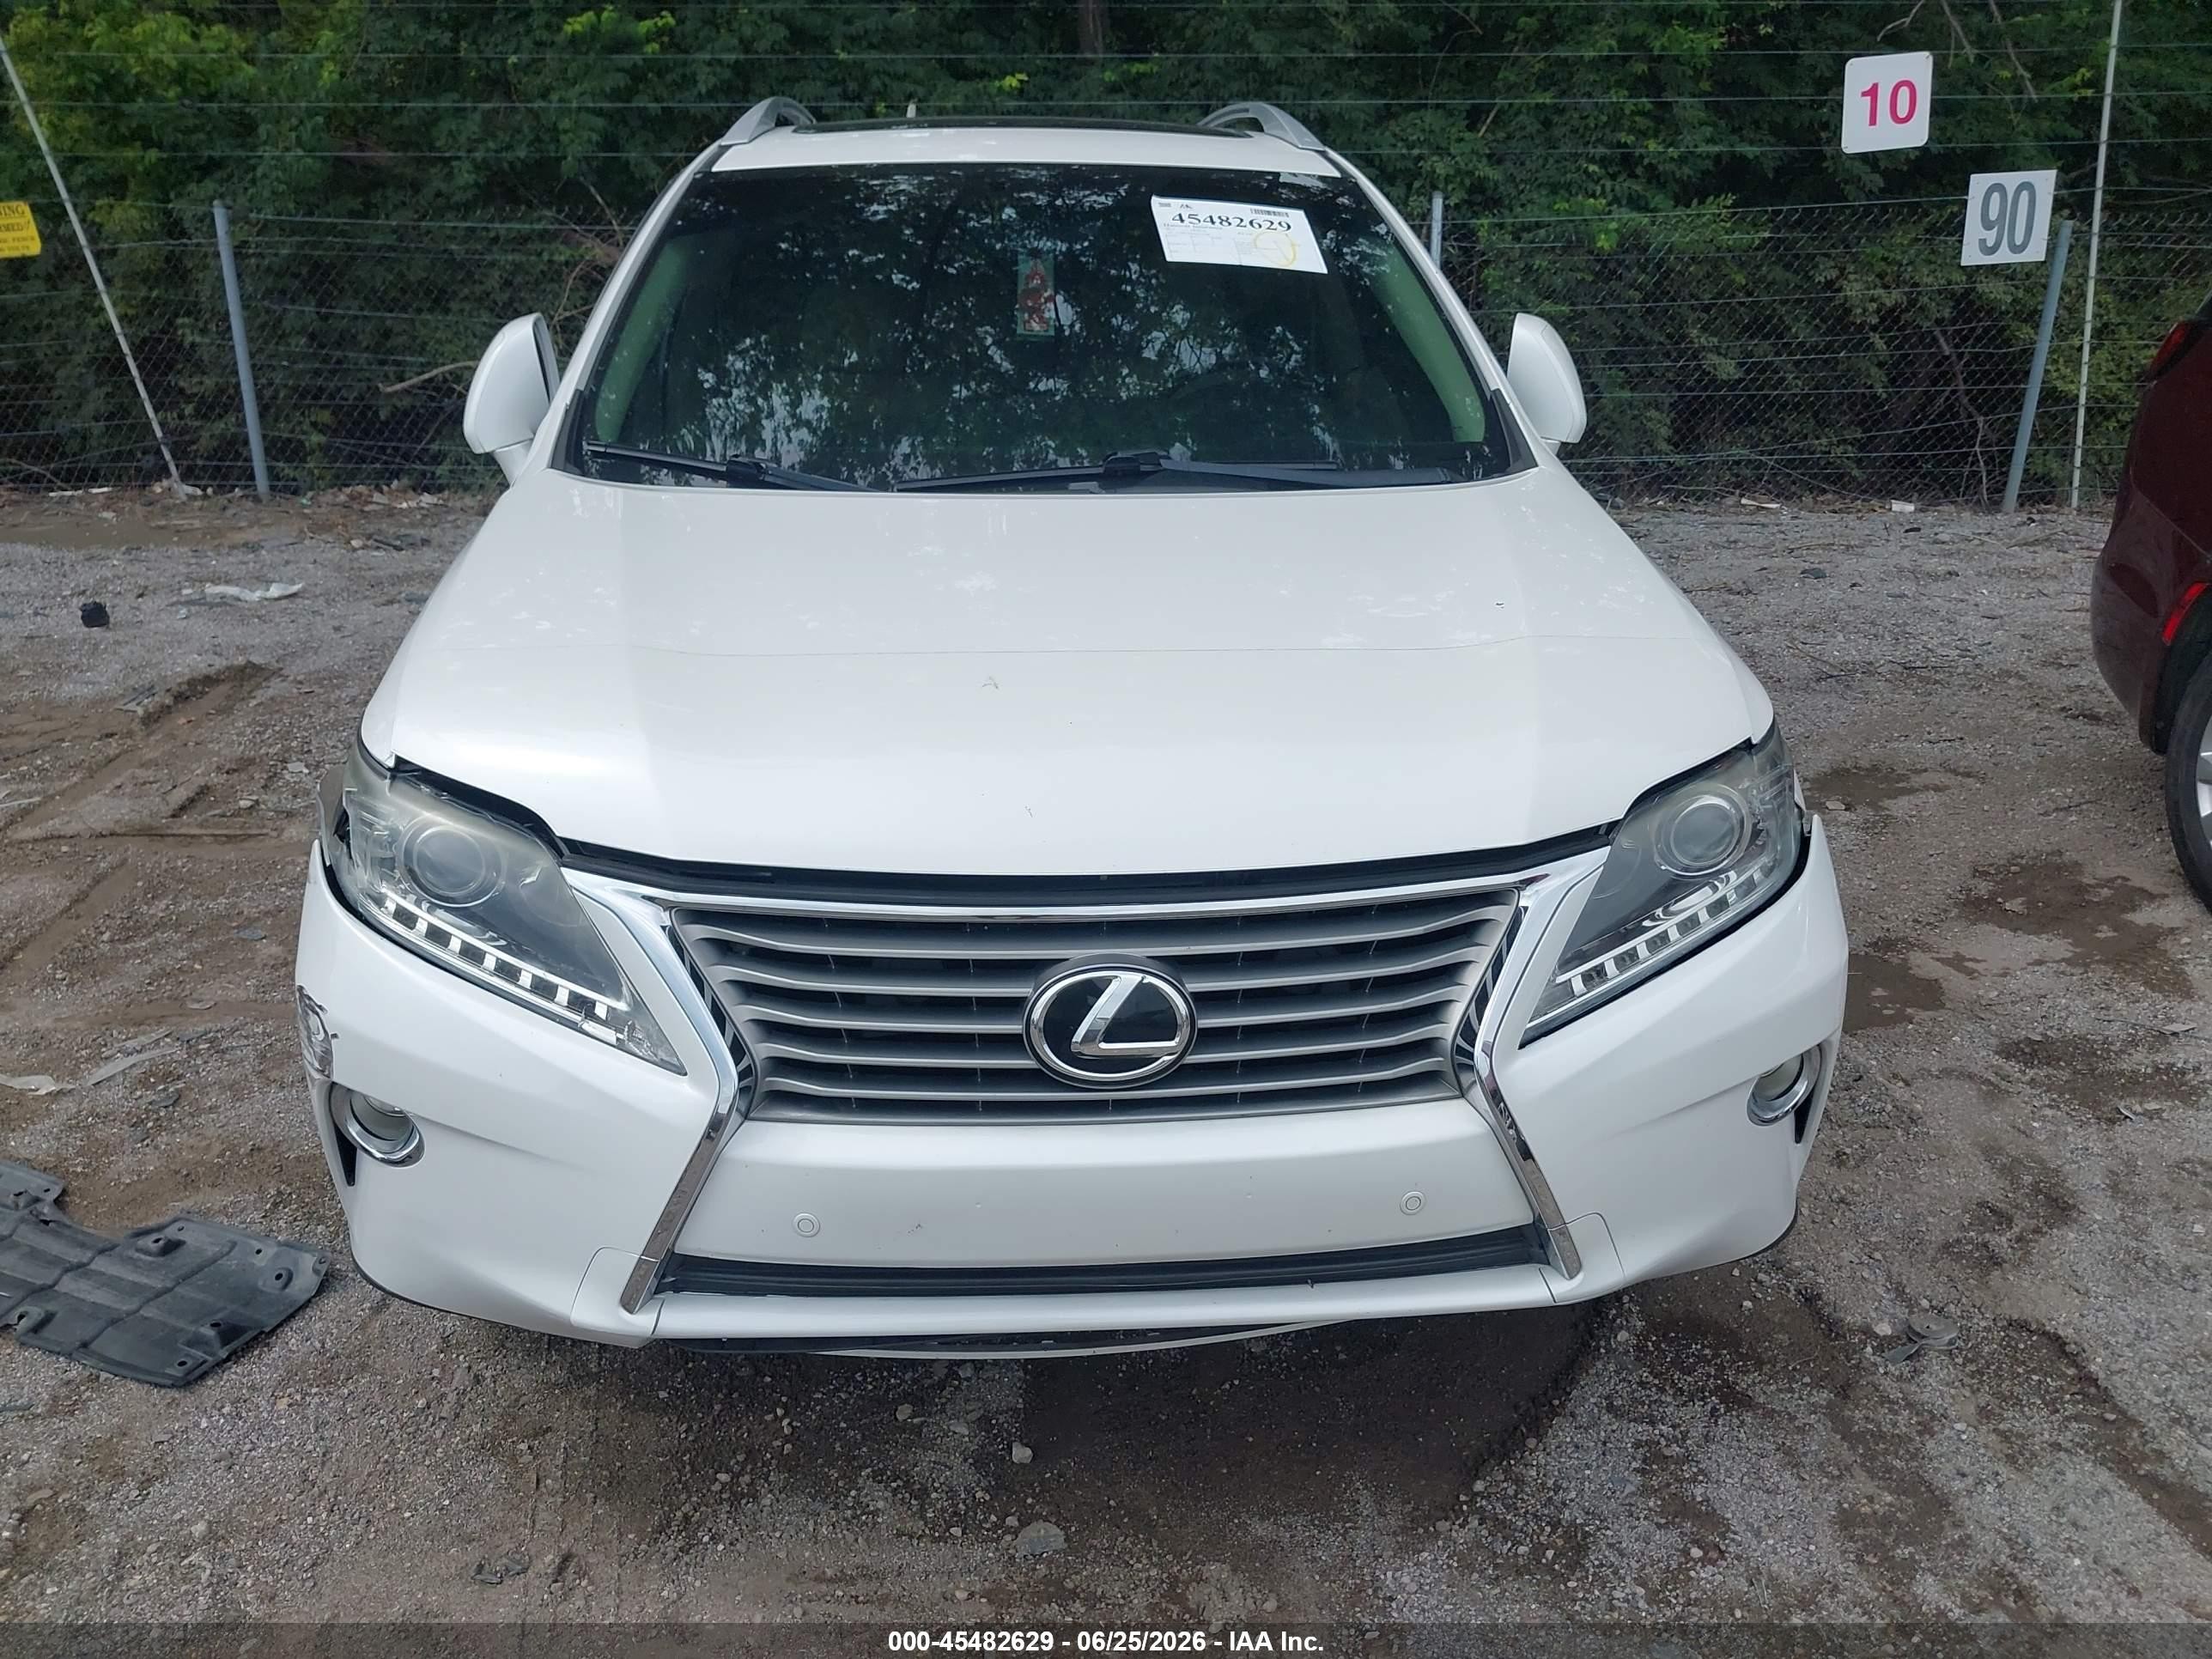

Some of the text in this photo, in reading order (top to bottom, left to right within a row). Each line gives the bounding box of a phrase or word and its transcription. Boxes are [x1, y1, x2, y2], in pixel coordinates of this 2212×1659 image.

[1860, 80, 1917, 126] 10
[0, 204, 25, 216] ING
[1171, 212, 1291, 232] 45482629
[1978, 180, 2037, 256] 90
